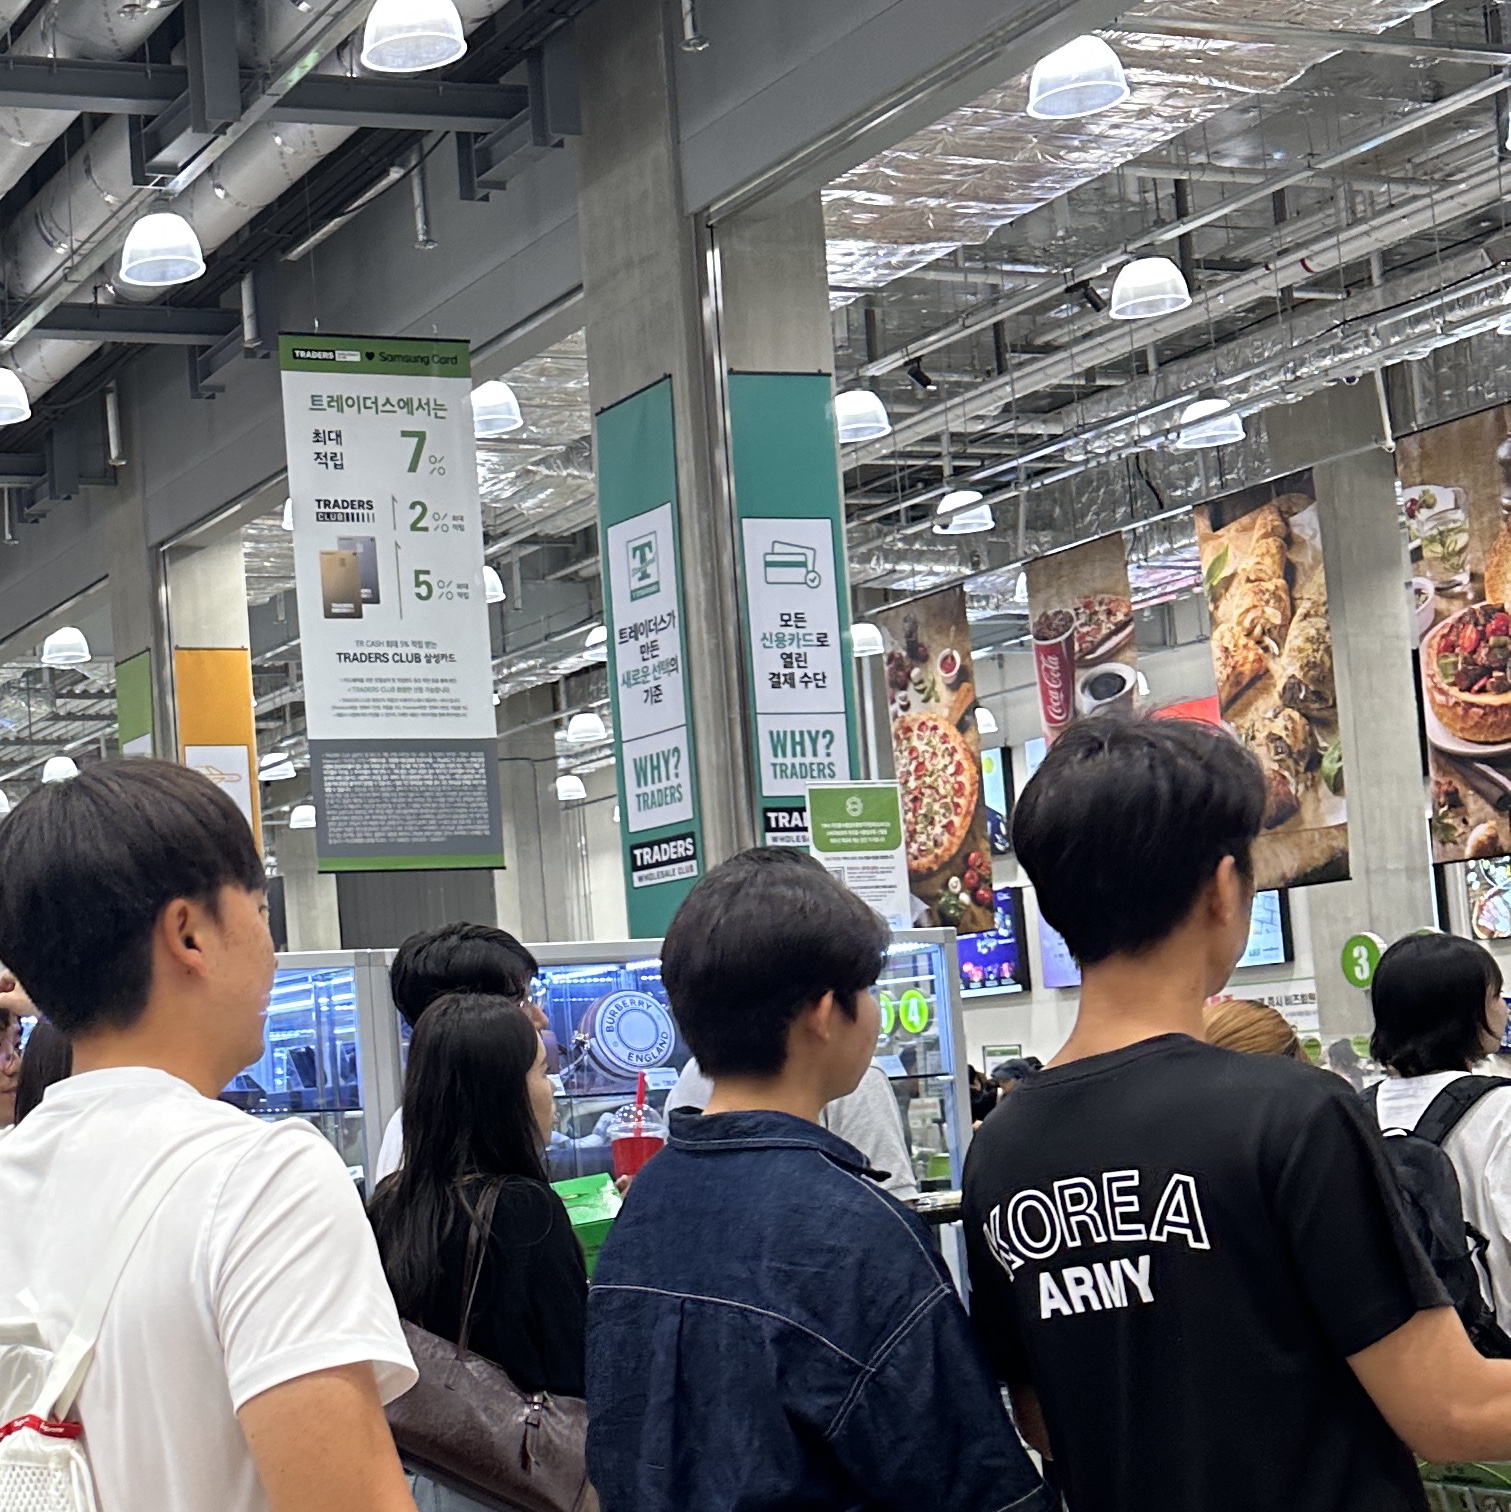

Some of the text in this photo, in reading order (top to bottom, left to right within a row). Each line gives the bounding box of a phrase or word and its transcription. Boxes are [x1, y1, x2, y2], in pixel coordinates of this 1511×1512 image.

[294, 350, 335, 360] TRADERS
[379, 352, 458, 366] Samsung Card
[309, 394, 448, 419] 트레이더스에서는
[312, 429, 342, 447] 최대
[313, 451, 344, 470] 적립
[315, 499, 375, 511] TRADERS
[618, 609, 676, 645] 트레이더스가
[780, 613, 807, 629] 모든
[640, 640, 660, 661] 만든
[761, 633, 830, 649] 신용카드로
[336, 653, 457, 664] TRADERS CLUB 삼성카드
[780, 652, 807, 668] 열린
[621, 665, 651, 688] 새로운
[768, 672, 827, 689] 결제 수단
[643, 684, 663, 705] 기준
[769, 729, 835, 758] WHY?
[633, 747, 681, 788] WHY?
[771, 762, 836, 779] TRADERS
[635, 784, 683, 812] TRADERS
[633, 838, 694, 866] TRADERS
[1353, 945, 1370, 980] 3
[606, 999, 652, 1033] BURBERRY
[628, 1031, 668, 1062] ENGLAND
[983, 1169, 1211, 1281] KOREA
[1038, 1255, 1155, 1319] ARMY
